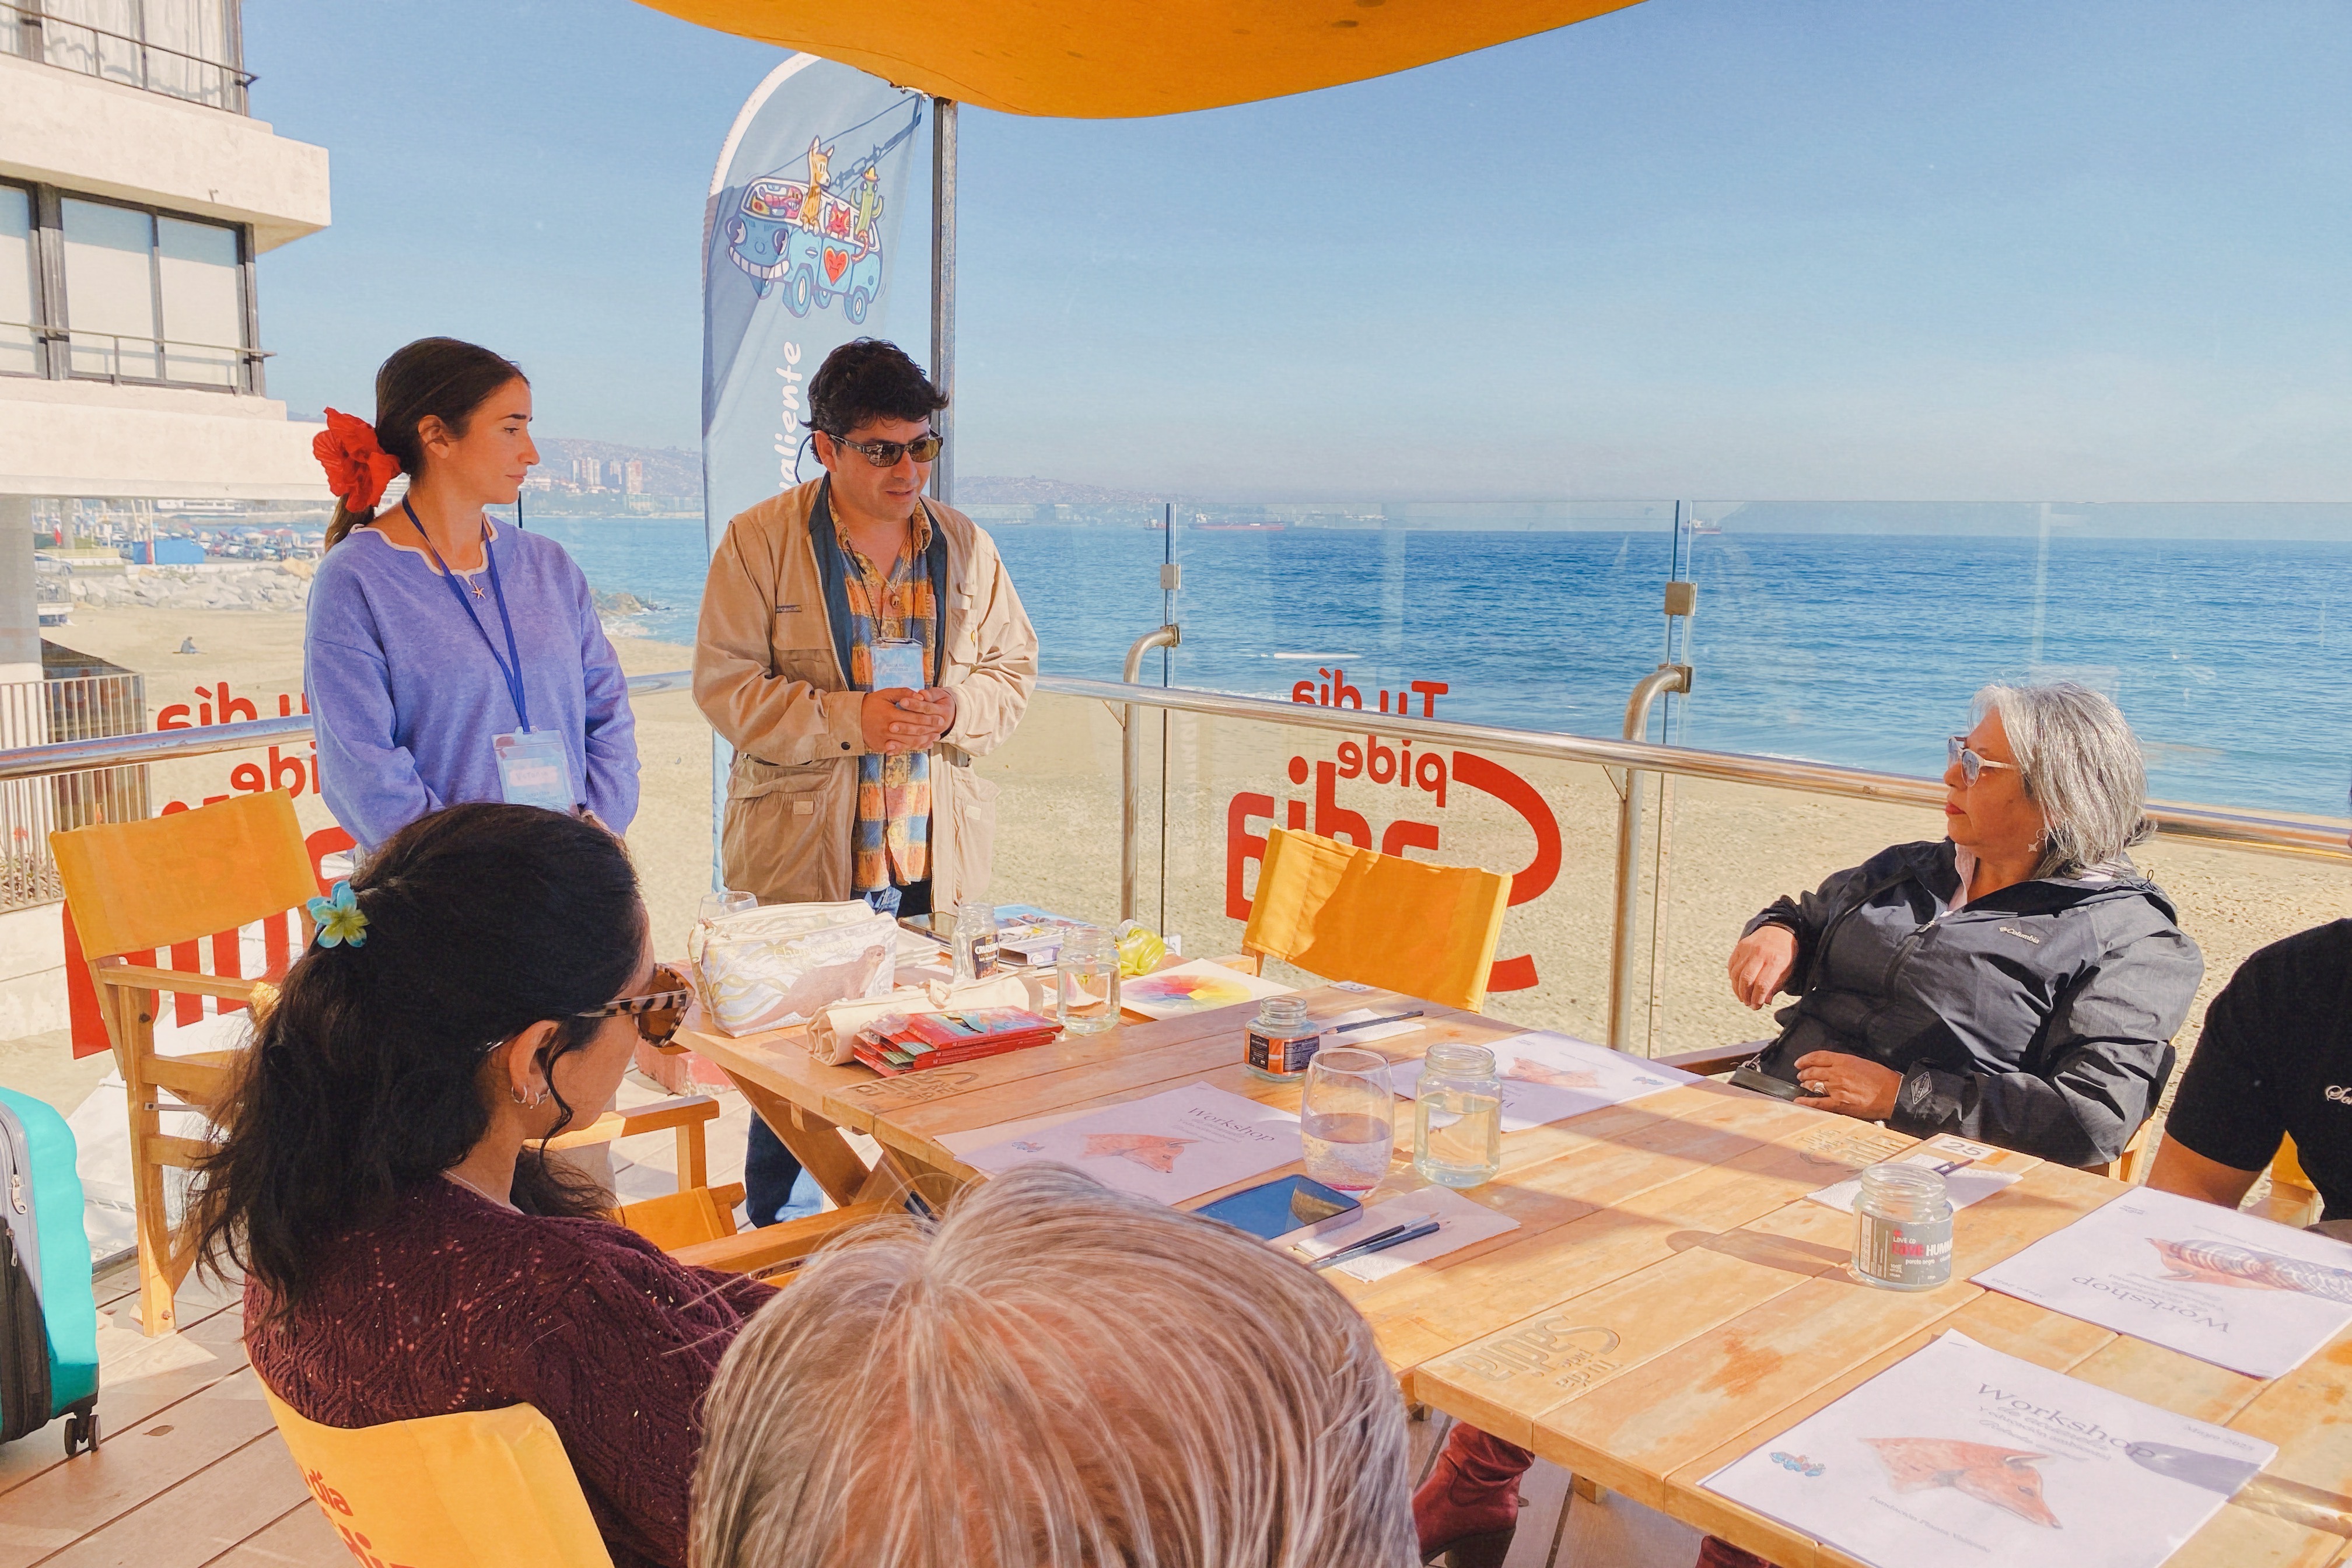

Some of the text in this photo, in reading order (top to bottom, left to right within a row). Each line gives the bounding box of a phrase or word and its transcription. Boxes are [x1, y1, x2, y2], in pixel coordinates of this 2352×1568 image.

[2007, 928, 2040, 944] Columbia
[1188, 1107, 1275, 1142] Workshop
[1940, 1141, 1983, 1156] 25
[1892, 1242, 1924, 1257] LOVE
[1893, 1236, 1908, 1244] LOVE
[2071, 1276, 2230, 1334] Workshop
[1450, 1314, 1621, 1382] Sadia
[1558, 1348, 1594, 1368] pide
[1978, 1382, 2155, 1459] Workshop
